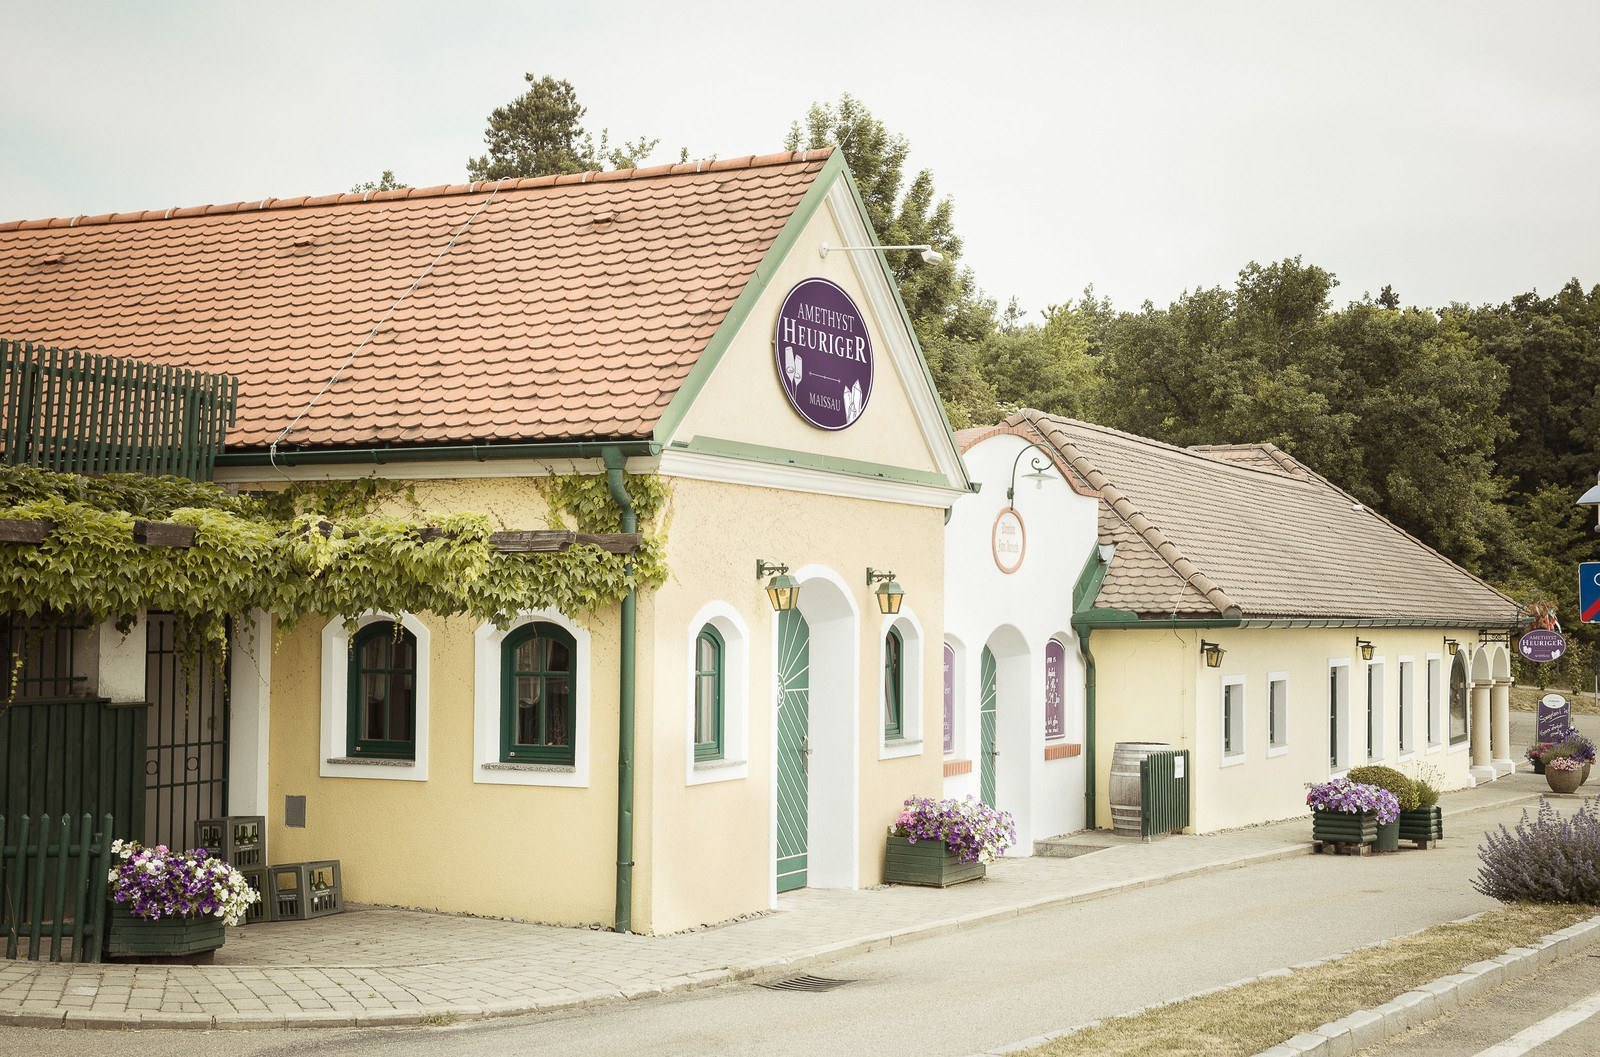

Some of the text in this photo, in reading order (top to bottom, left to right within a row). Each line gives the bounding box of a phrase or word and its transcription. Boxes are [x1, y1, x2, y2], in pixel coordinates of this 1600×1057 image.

[797, 302, 855, 333] AMETHYST
[782, 316, 867, 364] HEURIGER
[809, 392, 841, 412] MAISSAU
